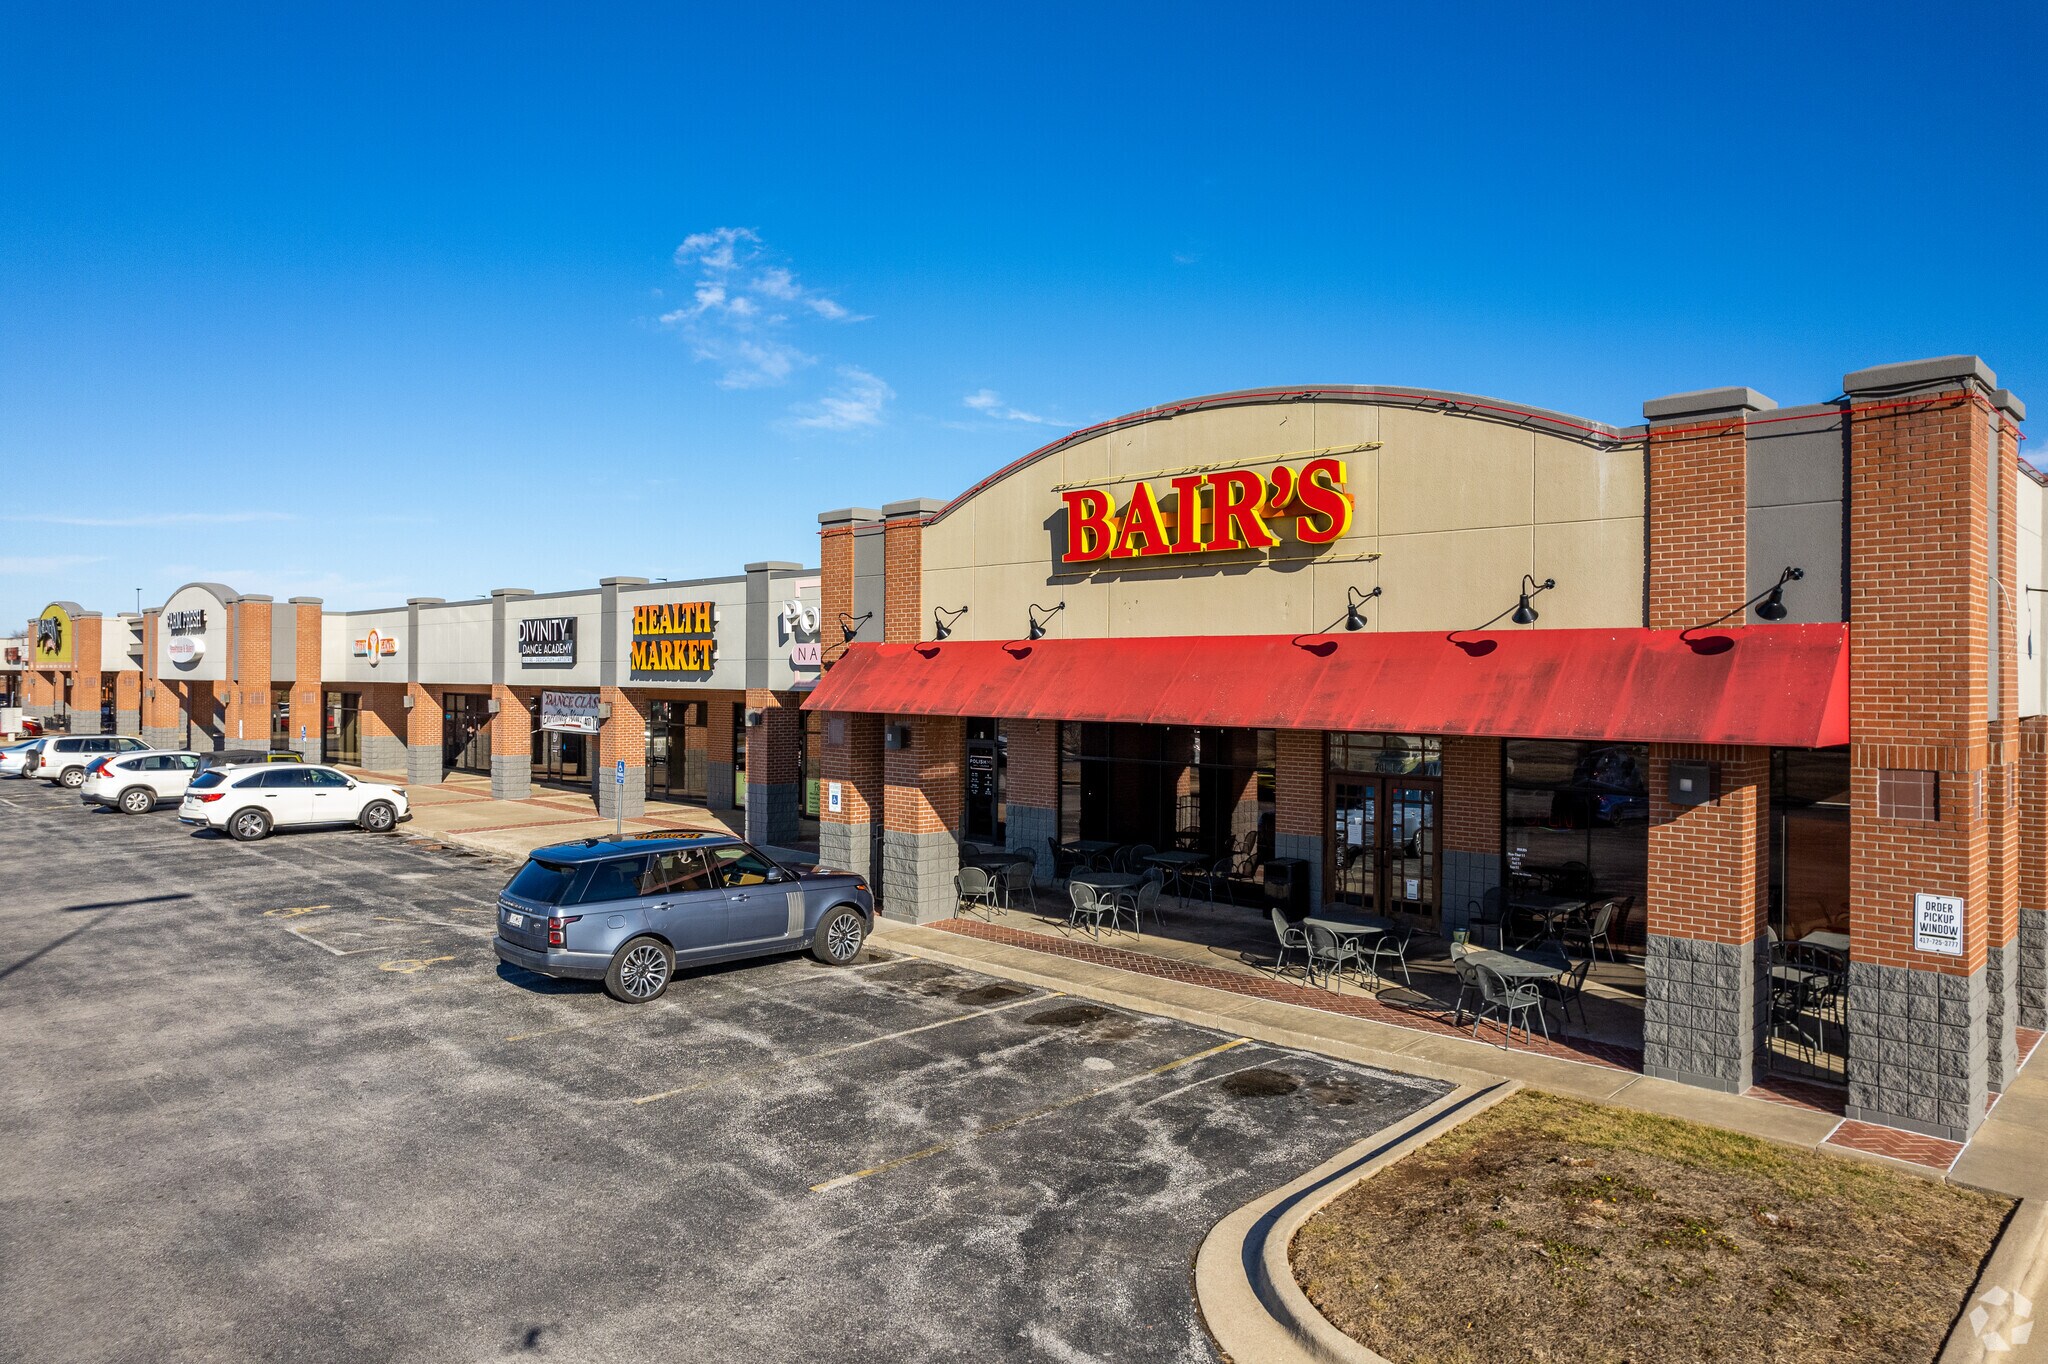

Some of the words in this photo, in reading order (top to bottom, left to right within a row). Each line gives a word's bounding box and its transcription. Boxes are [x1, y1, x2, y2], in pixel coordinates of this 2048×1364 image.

[1061, 458, 1353, 563] BAIR'S
[633, 601, 711, 635] HEALTH
[783, 600, 820, 636] PO
[518, 619, 568, 641] DIVINITY
[522, 644, 542, 654] DANCE
[543, 642, 573, 654] ACADEMY
[631, 639, 713, 671] MARKET
[544, 692, 574, 708] DANCE
[1926, 901, 1953, 913] ORDER
[1924, 912, 1954, 924] PICKUP
[1919, 922, 1958, 936] WINDOW
